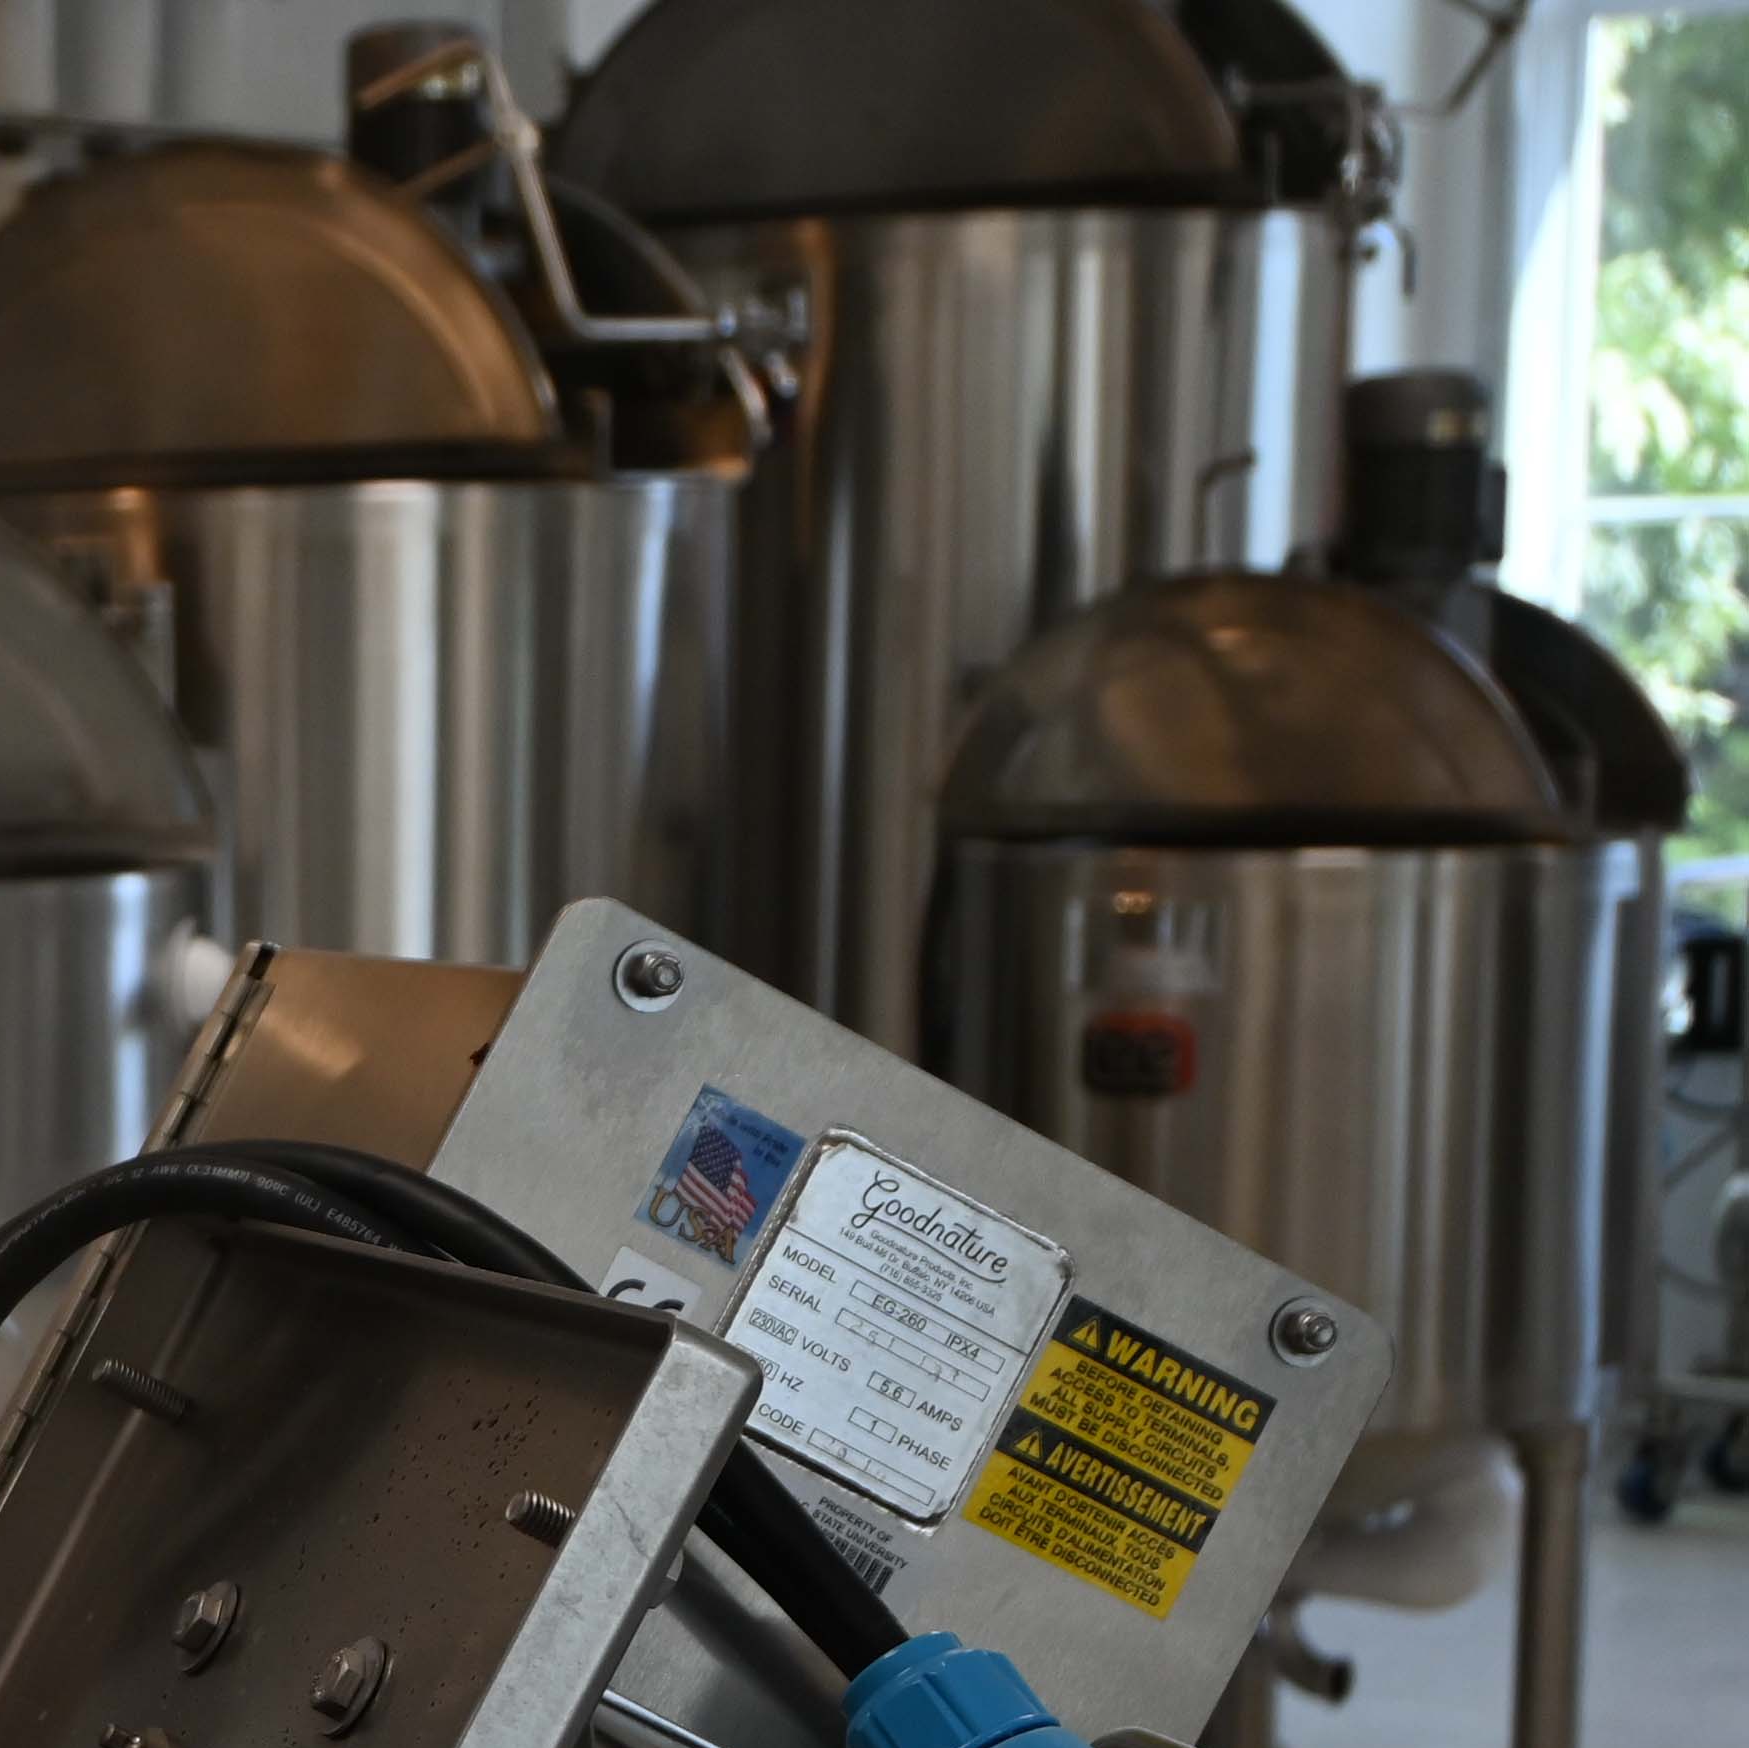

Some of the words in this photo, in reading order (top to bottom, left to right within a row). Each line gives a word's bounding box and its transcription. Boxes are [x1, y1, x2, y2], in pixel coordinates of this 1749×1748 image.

[649, 1185, 734, 1264] USA
[849, 1170, 1009, 1284] Goodnature
[767, 1273, 825, 1313] SERIAL
[782, 1245, 840, 1284] MODEL
[871, 1293, 928, 1332] EG-260
[944, 1332, 980, 1360] IPX4
[974, 1299, 995, 1317] USA
[751, 1309, 796, 1342] 230VAC
[798, 1336, 852, 1373] VOLTS
[878, 1379, 904, 1400] 5.6
[915, 1398, 963, 1432] AMPS
[756, 1401, 805, 1435] CODE
[1049, 1364, 1117, 1409] ACCESS
[1117, 1400, 1140, 1421] TO
[1141, 1411, 1234, 1472] TERMINALS,
[1075, 1358, 1138, 1401] BEFORE
[1138, 1391, 1225, 1447] OBTAINING
[1100, 1324, 1264, 1436] WARNING
[779, 1371, 804, 1392] HZ
[897, 1433, 952, 1471] PHASE
[1027, 1389, 1076, 1425] MUST
[1076, 1415, 1101, 1437] BE
[1101, 1426, 1225, 1504] DISCONNECTED
[1050, 1383, 1080, 1408] ALL
[1081, 1398, 1142, 1441] SUPPLY
[1143, 1431, 1219, 1481] CIRCUITS
[811, 1507, 846, 1533] STATE
[844, 1526, 909, 1571] UNIVERSITY
[818, 1494, 877, 1535] PROPERTY
[875, 1528, 894, 1544] OF
[1007, 1463, 1053, 1497] AVANT
[1054, 1487, 1128, 1535] D'OBTENIR
[1007, 1481, 1038, 1507] AUX
[1122, 1541, 1163, 1571] TOUS
[1043, 1435, 1207, 1546] AVERTISSEMENT
[978, 1503, 1015, 1532] DOIT
[1014, 1518, 1053, 1550] ÊTRE
[1050, 1539, 1161, 1610] DISCONNECTED
[987, 1489, 1056, 1536] CIRCUITS
[1054, 1523, 1167, 1595] D'ALIMENTATION
